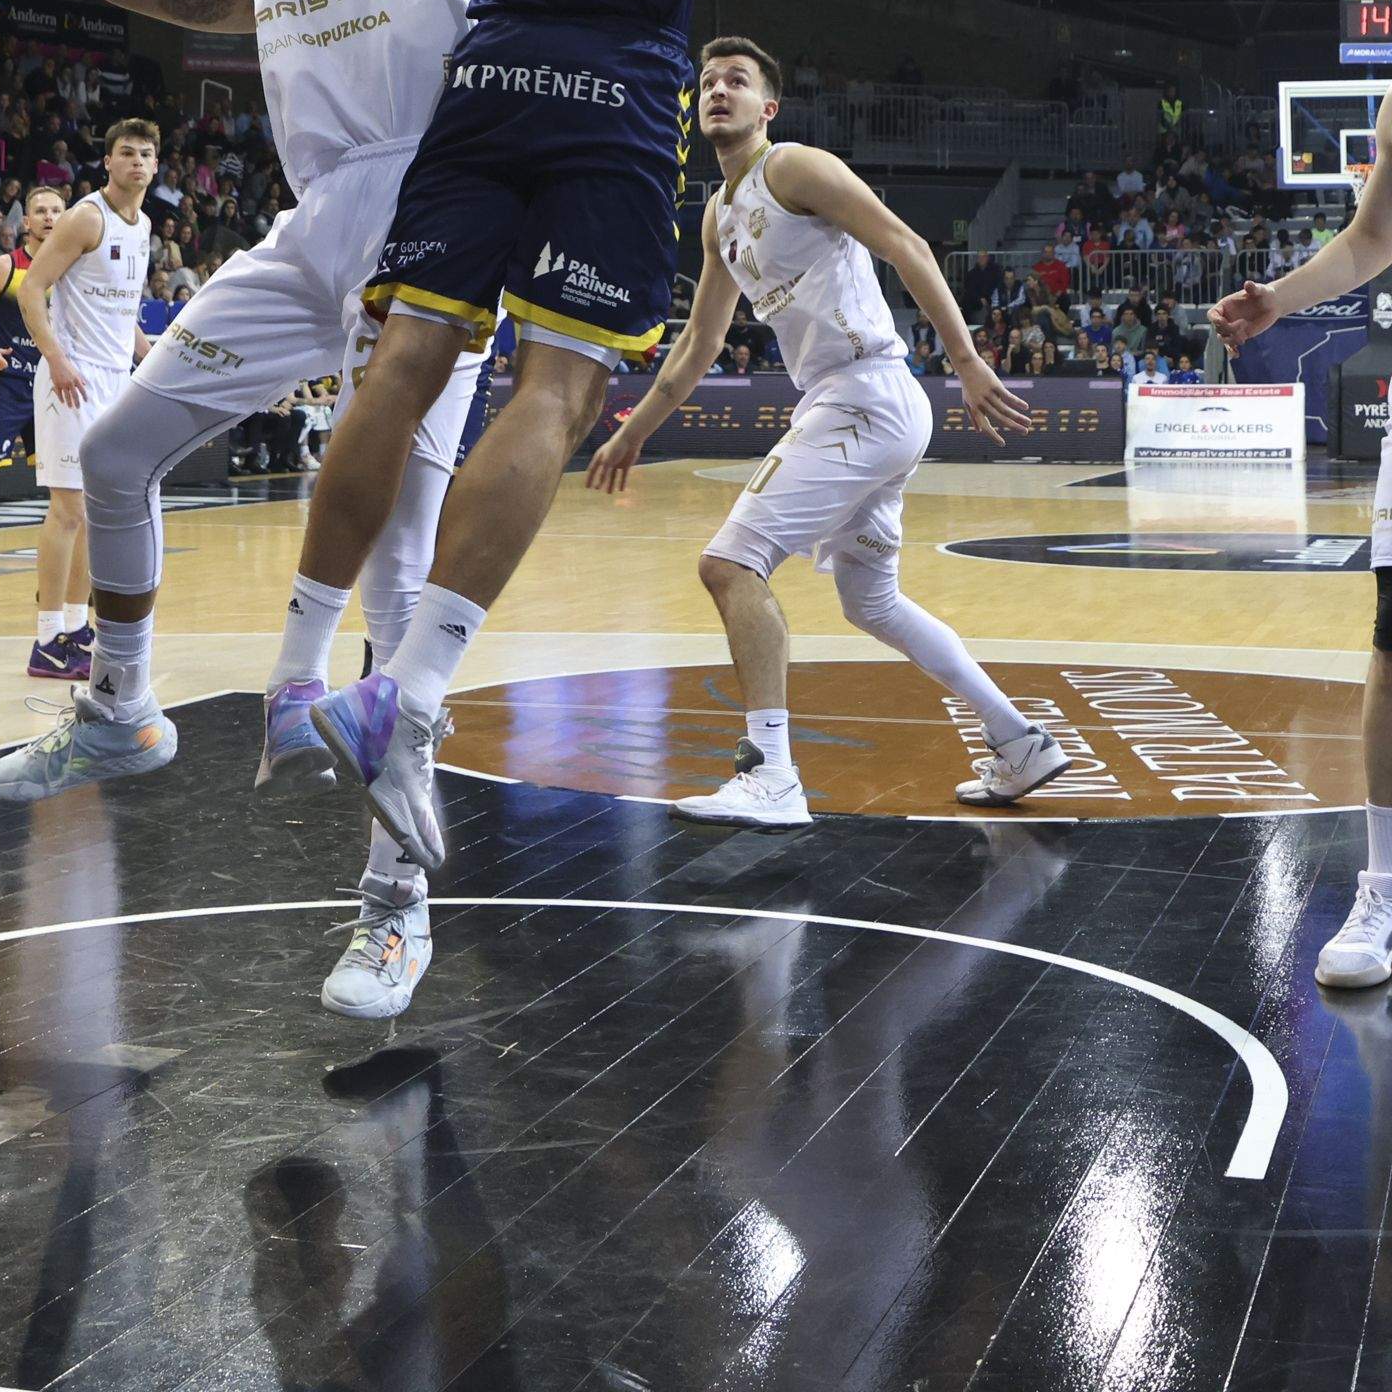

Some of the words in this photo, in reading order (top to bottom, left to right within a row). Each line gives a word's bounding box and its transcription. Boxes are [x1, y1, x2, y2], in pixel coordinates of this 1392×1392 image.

[1360, 5, 1391, 36] 14
[568, 260, 599, 280] PAL
[565, 273, 631, 303] ARINSAL
